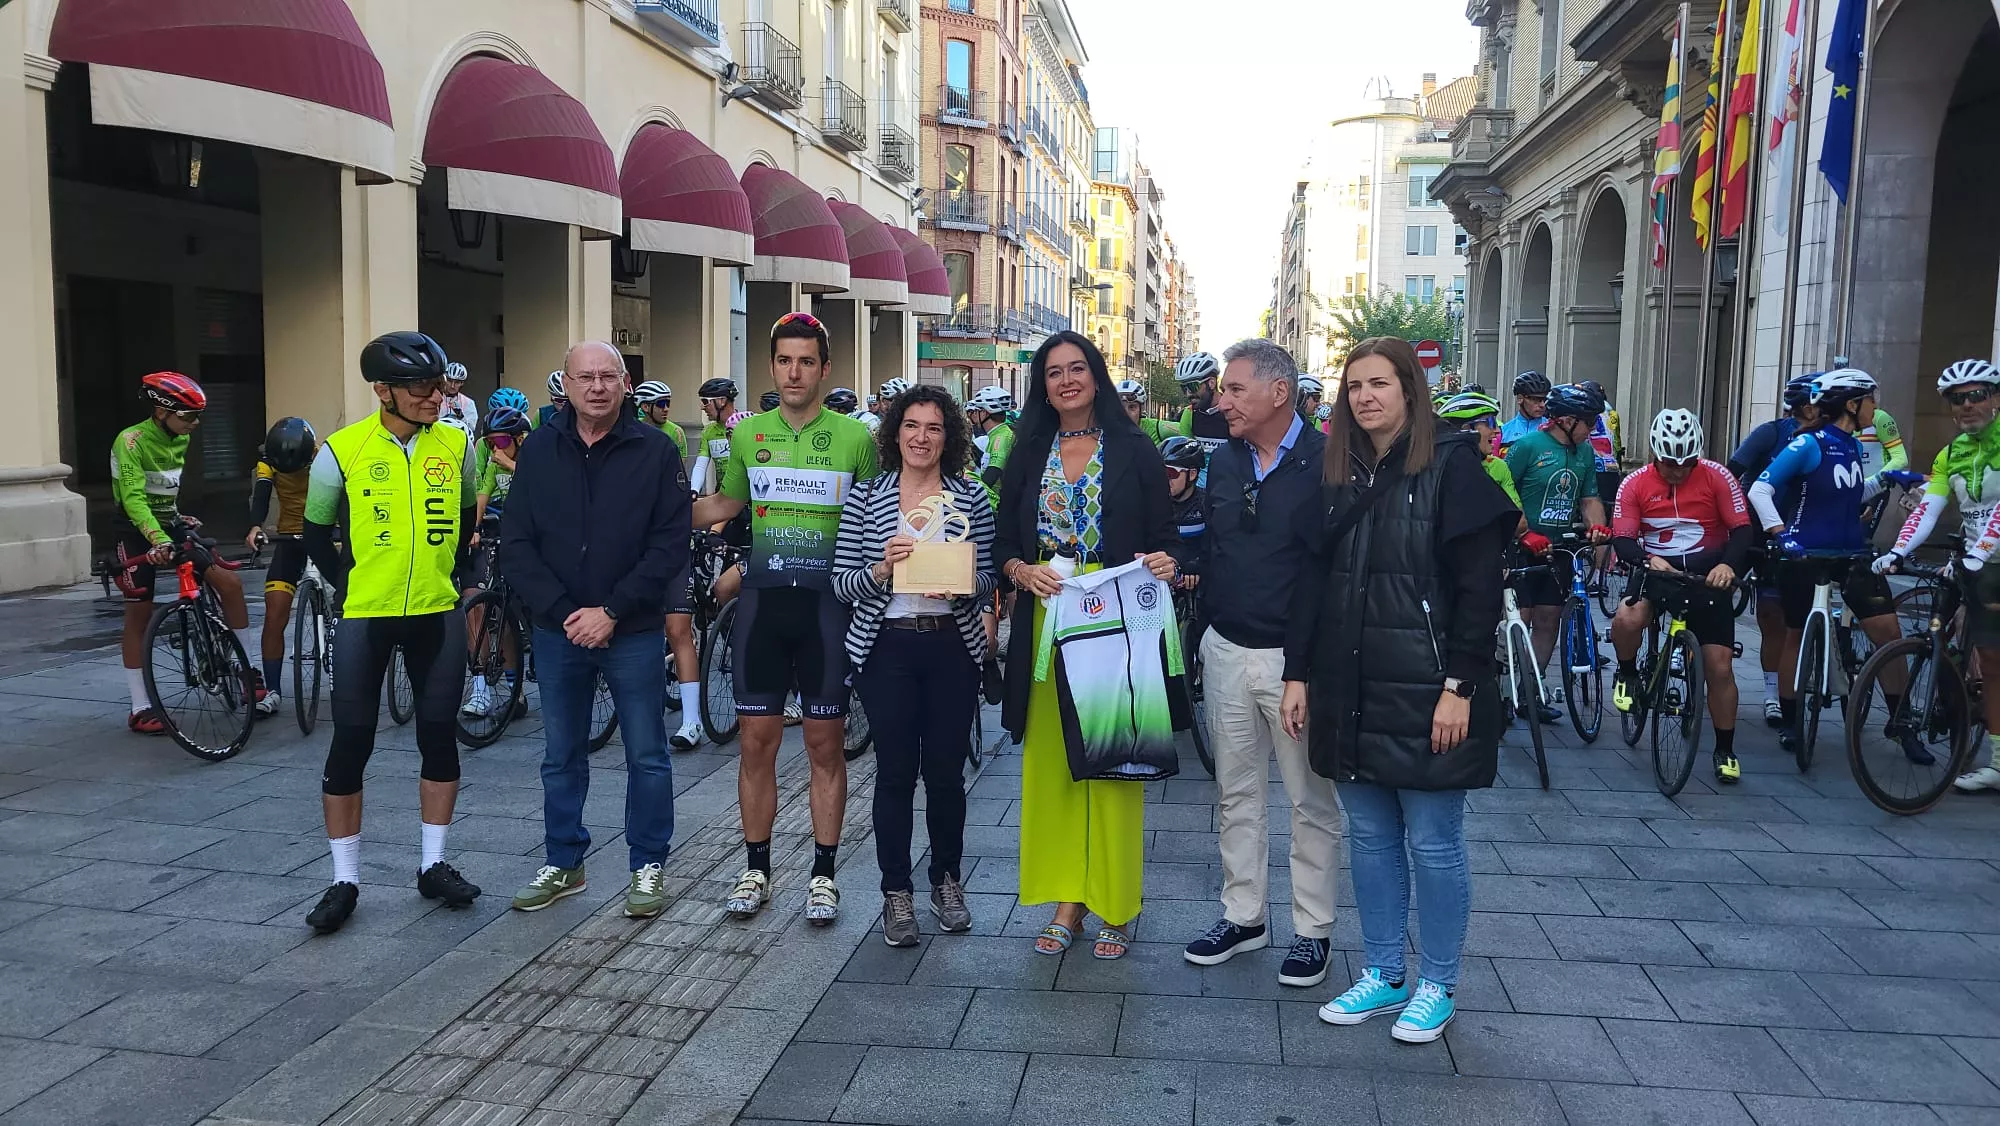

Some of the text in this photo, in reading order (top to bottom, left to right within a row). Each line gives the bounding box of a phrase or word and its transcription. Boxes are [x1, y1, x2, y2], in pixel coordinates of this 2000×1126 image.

[775, 477, 827, 489] RENAULT
[775, 486, 827, 496] AUTO CUATRO
[1899, 501, 1930, 543] HUESCA
